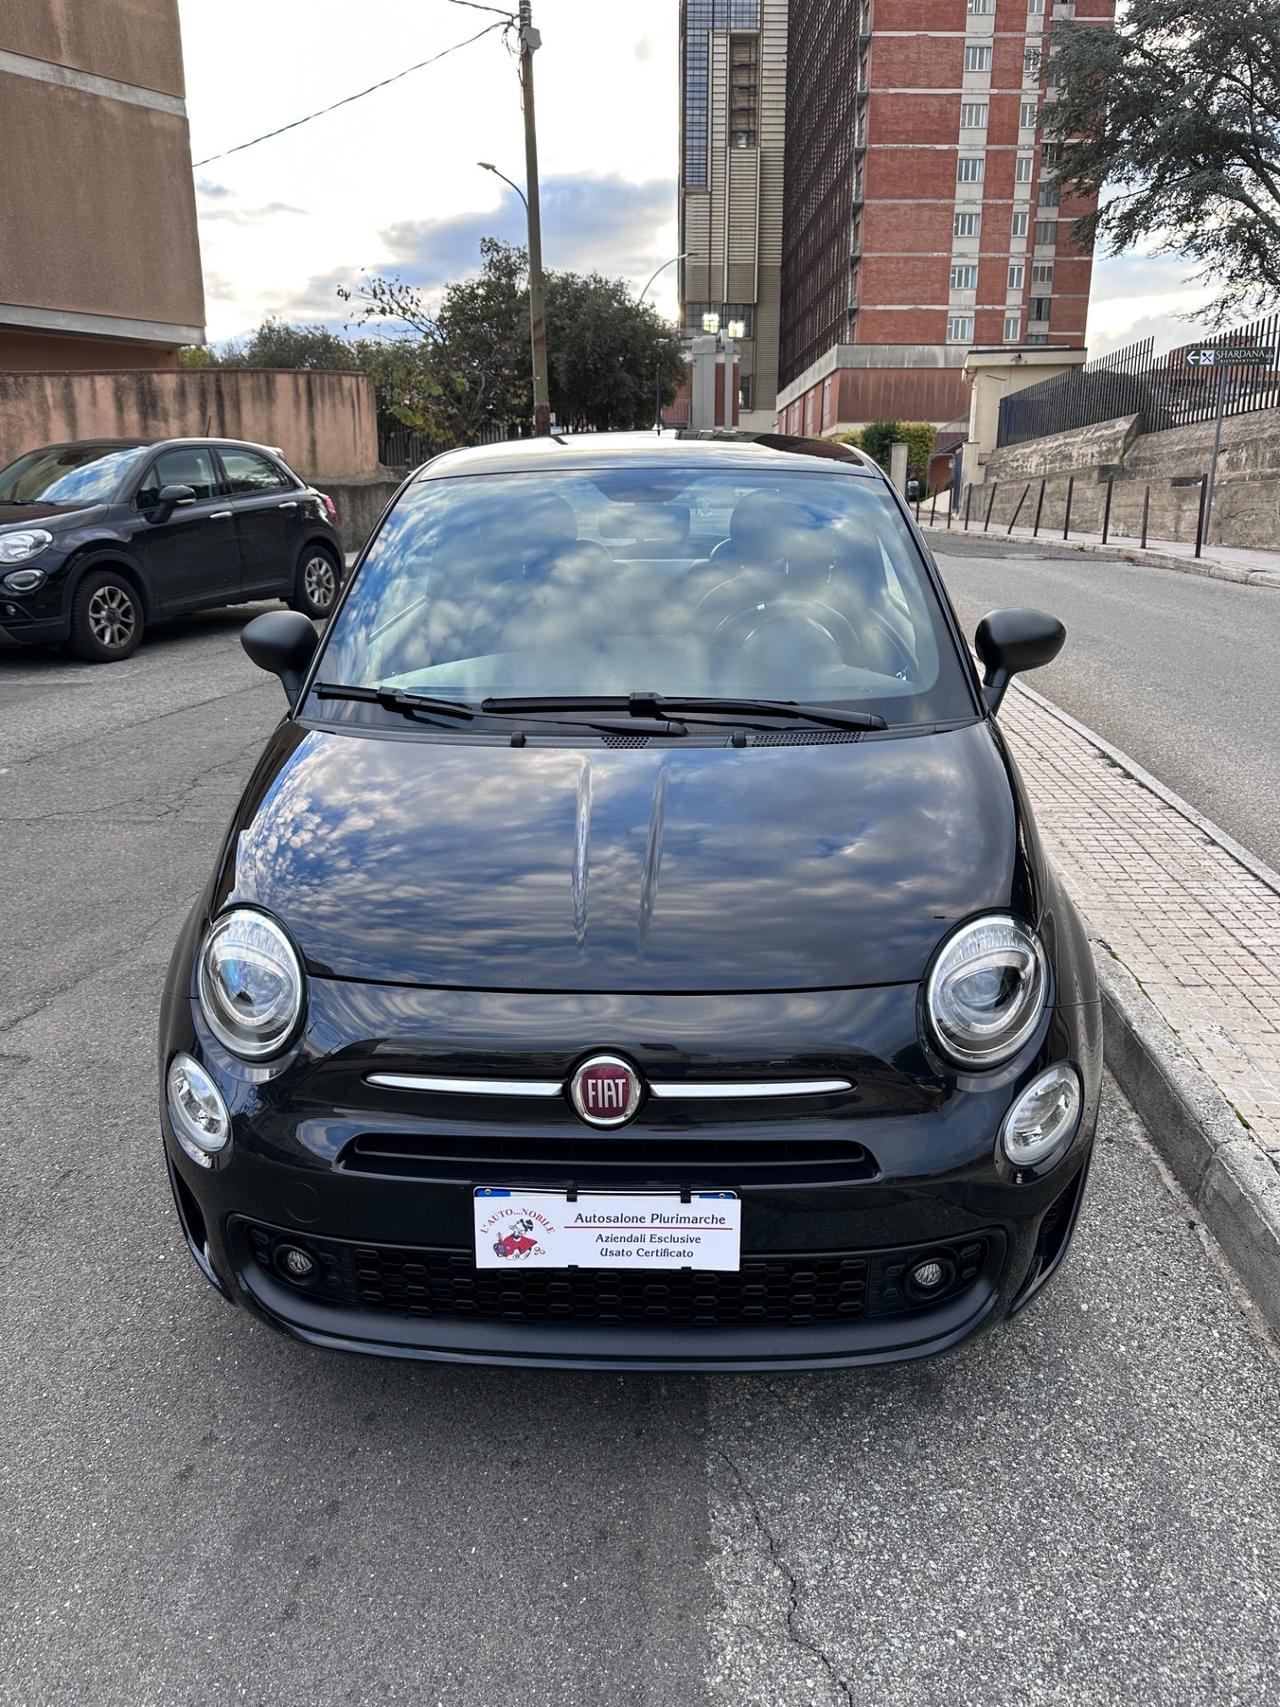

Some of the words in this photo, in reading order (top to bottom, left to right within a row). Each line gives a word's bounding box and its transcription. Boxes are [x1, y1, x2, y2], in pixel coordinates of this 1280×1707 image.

[1216, 350, 1265, 360] SHARDANA
[587, 1078, 627, 1108] FIAT
[574, 1212, 646, 1224] Autosalone
[650, 1213, 726, 1225] Plurimarche
[595, 1233, 646, 1244] Aziendali
[650, 1233, 701, 1244] Esclusive
[600, 1247, 633, 1258] Usato
[636, 1247, 694, 1258] Certificato
